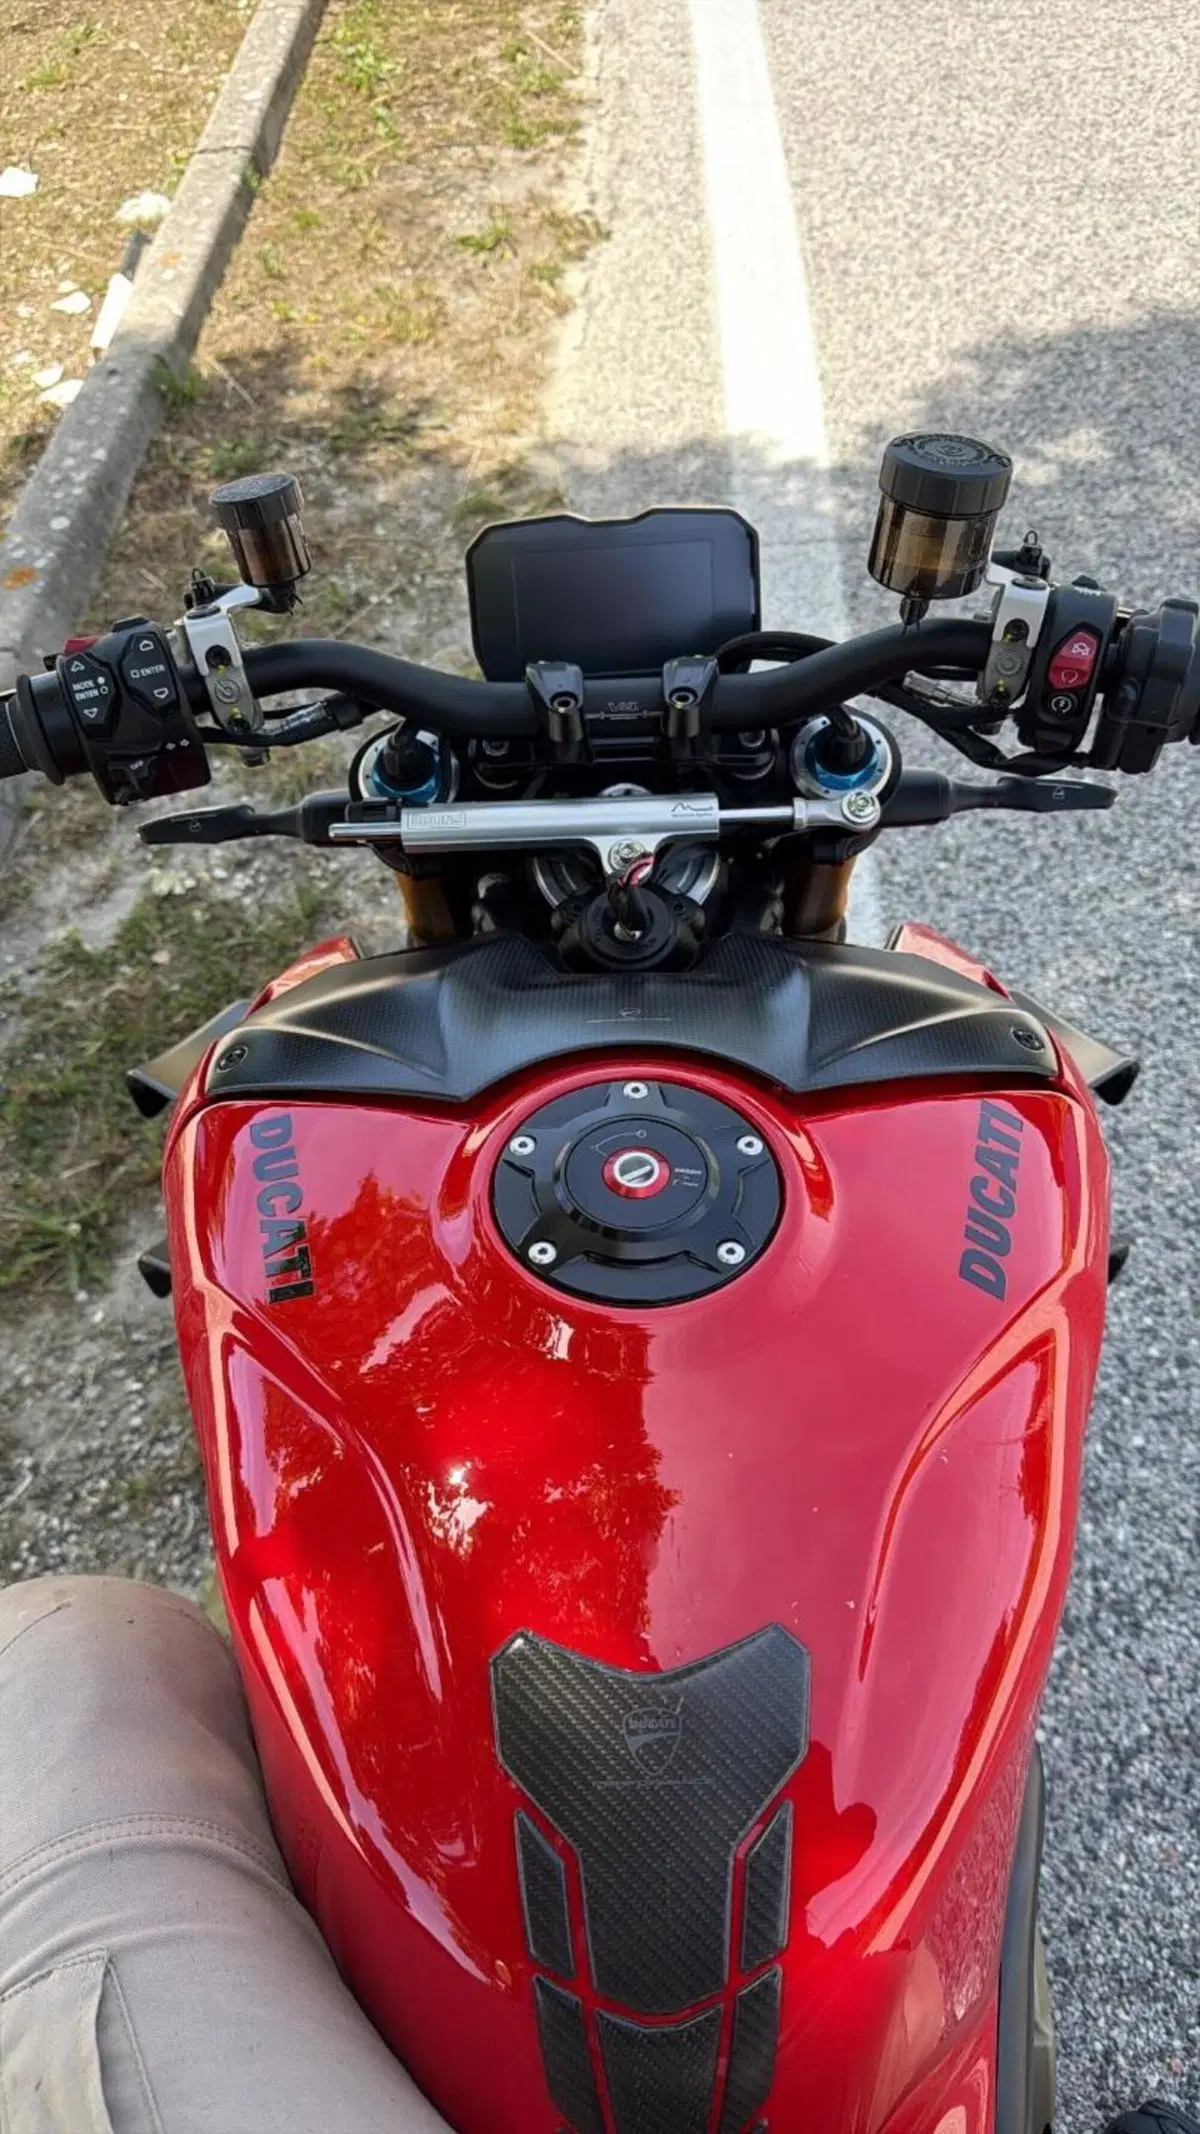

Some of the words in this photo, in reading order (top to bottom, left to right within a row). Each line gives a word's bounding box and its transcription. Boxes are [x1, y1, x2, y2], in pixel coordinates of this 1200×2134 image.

[75, 689, 99, 701] ENTER
[140, 664, 165, 676] ENTER
[249, 1112, 316, 1306] DUCATI
[958, 1098, 1024, 1303] DUCATI
